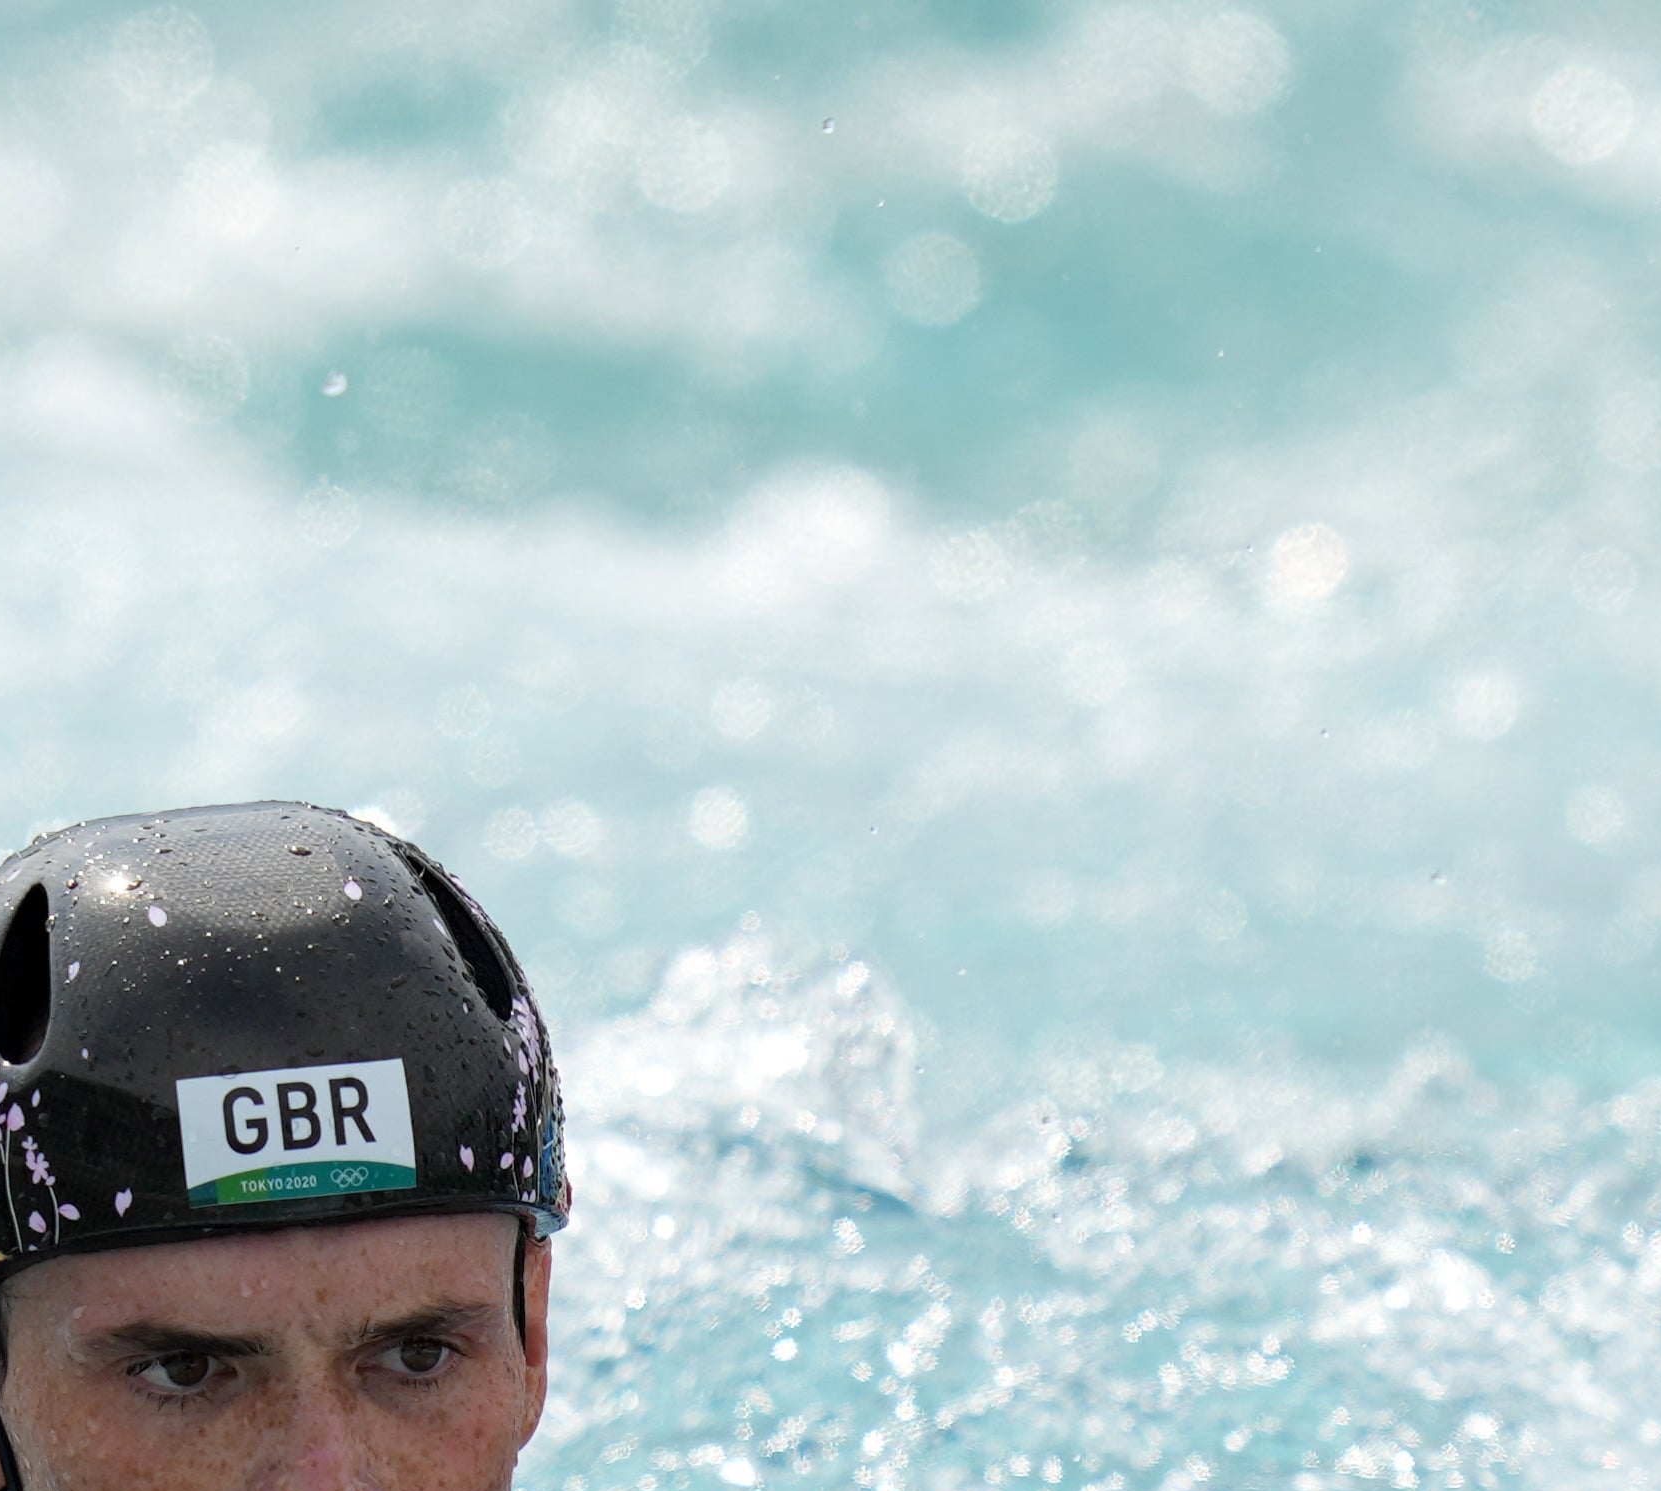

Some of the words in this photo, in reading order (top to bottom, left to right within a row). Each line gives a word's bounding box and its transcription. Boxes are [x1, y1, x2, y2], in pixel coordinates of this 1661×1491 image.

[221, 1076, 377, 1156] GBR
[240, 1177, 284, 1194] TOKYO
[285, 1174, 318, 1191] 2020
